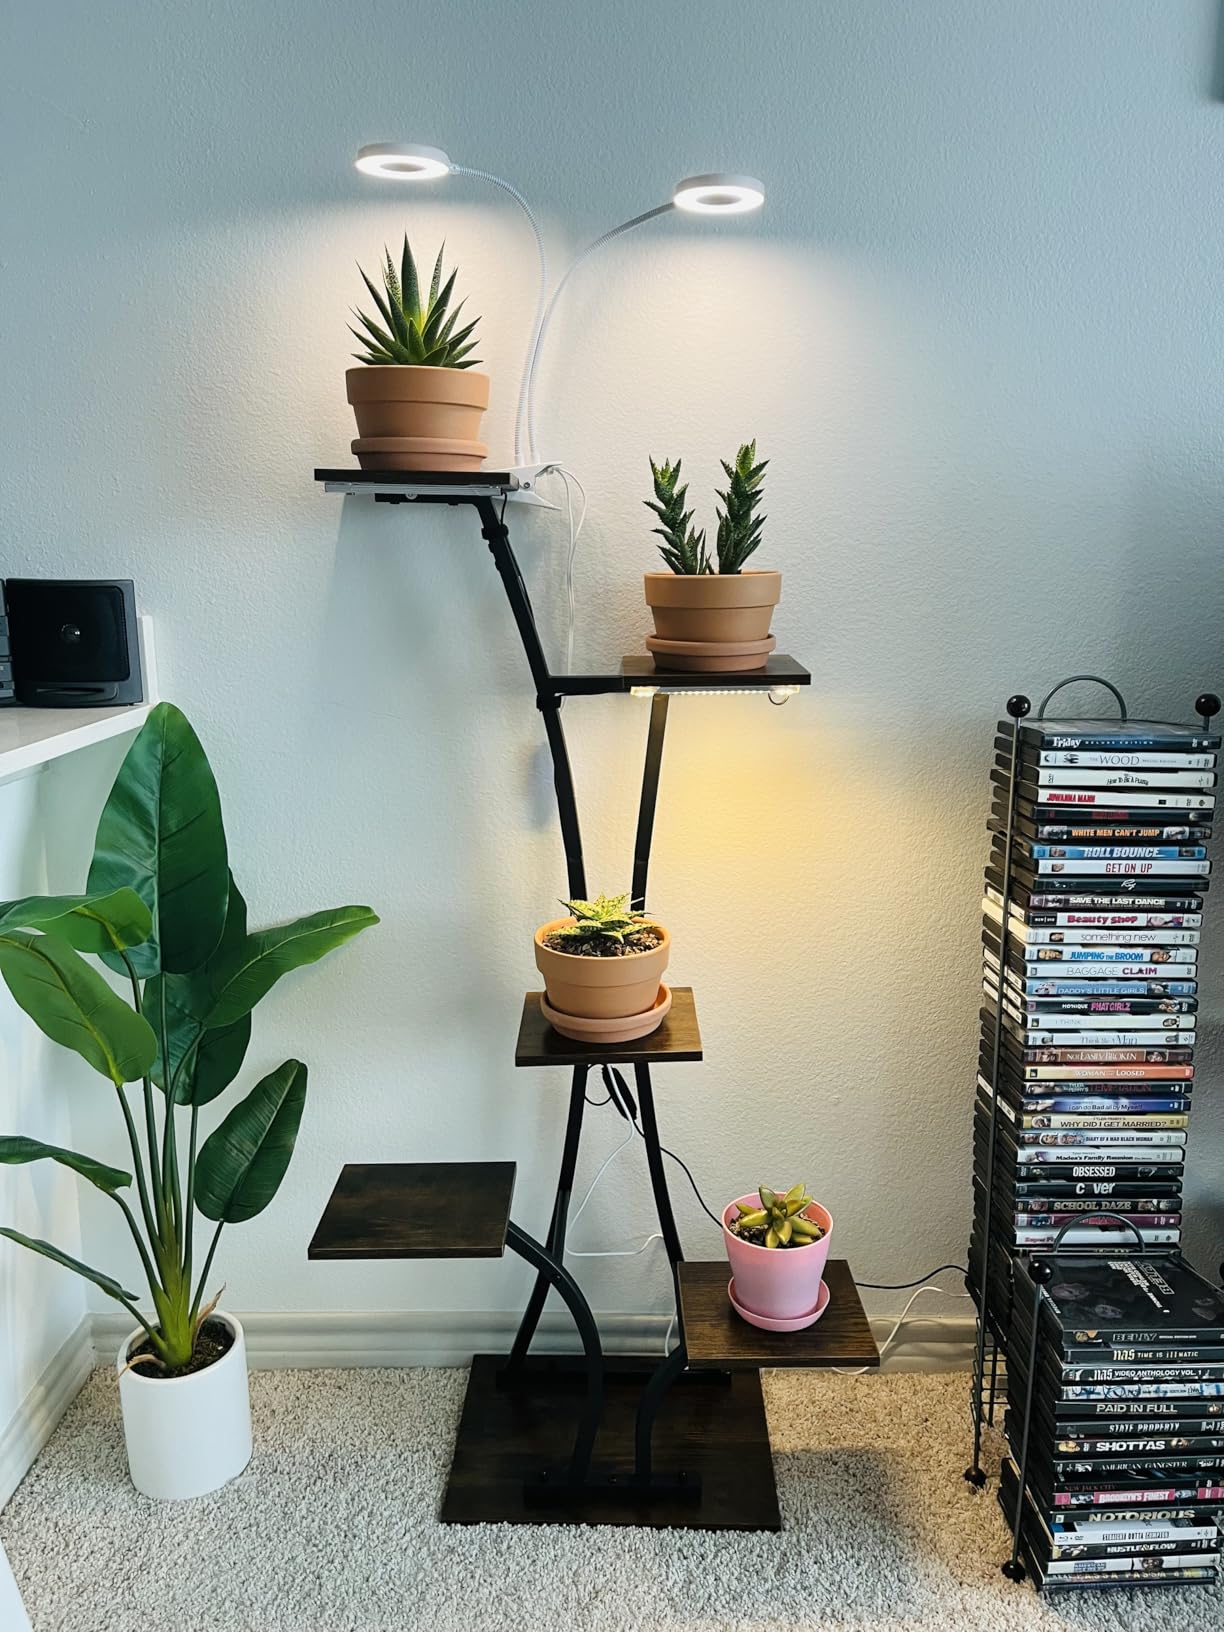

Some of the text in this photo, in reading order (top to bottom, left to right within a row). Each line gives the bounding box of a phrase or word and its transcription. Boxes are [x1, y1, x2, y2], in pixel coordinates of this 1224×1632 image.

[1052, 737, 1081, 748] Friday
[1100, 755, 1139, 765] WOOD
[1083, 848, 1159, 857] ROLL BOUNCE
[1106, 864, 1152, 872] GET ON UP
[1067, 915, 1109, 924] Beauty
[1081, 933, 1131, 943] something
[1070, 952, 1104, 960] JUMPING
[1115, 952, 1143, 960] BROOM
[1067, 967, 1118, 975] BAGGAGE
[1091, 1003, 1109, 1011] PHAT
[1073, 1167, 1115, 1177] OBSESSED
[1054, 1202, 1099, 1210] SCHOOL
[1113, 1349, 1135, 1360] nas
[1109, 1423, 1179, 1432] STATE PROPERTY
[1096, 1441, 1165, 1452] SHOTTAS
[1089, 1510, 1195, 1521] NOTORIOUS
[1107, 1545, 1139, 1553] HUSTLE
